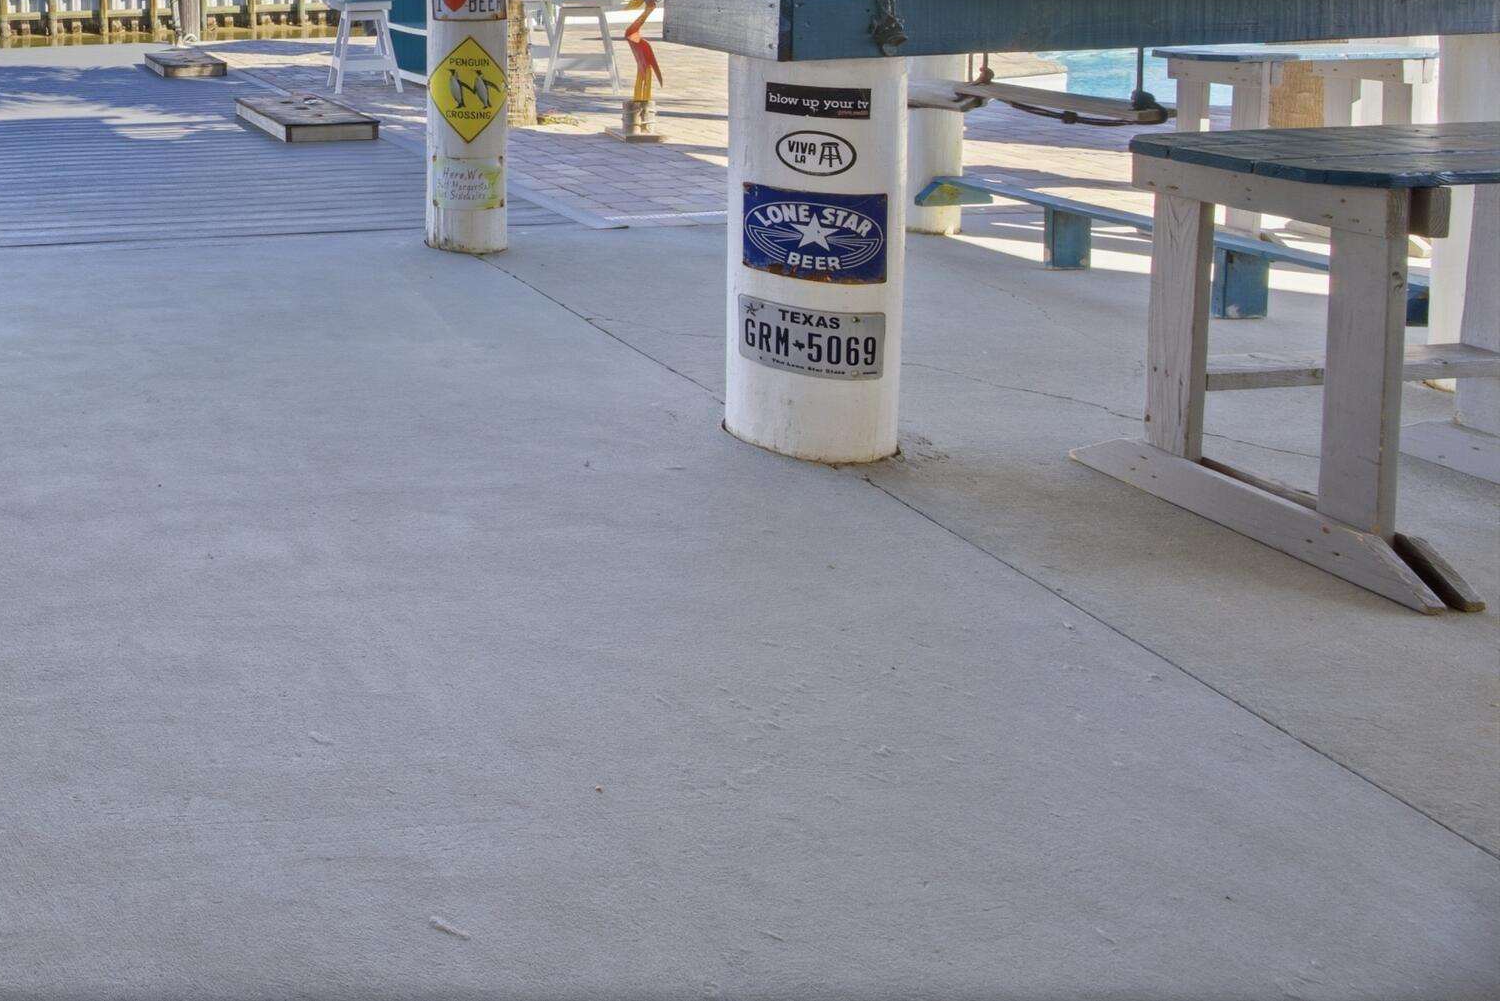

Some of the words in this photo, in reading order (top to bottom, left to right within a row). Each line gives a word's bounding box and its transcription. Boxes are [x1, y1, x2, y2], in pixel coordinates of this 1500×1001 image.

[449, 57, 490, 68] PENGUIN
[768, 92, 798, 105] blow
[802, 98, 820, 112] up
[823, 100, 854, 110] your
[445, 110, 491, 120] CROSSING
[788, 140, 817, 156] VIVA
[794, 152, 806, 164] LA
[753, 202, 809, 227] LONE
[819, 206, 873, 238] STAR
[786, 254, 842, 271] BEER
[778, 309, 840, 330] TEXAS
[745, 318, 789, 357] GRM
[807, 333, 877, 366] 5069
